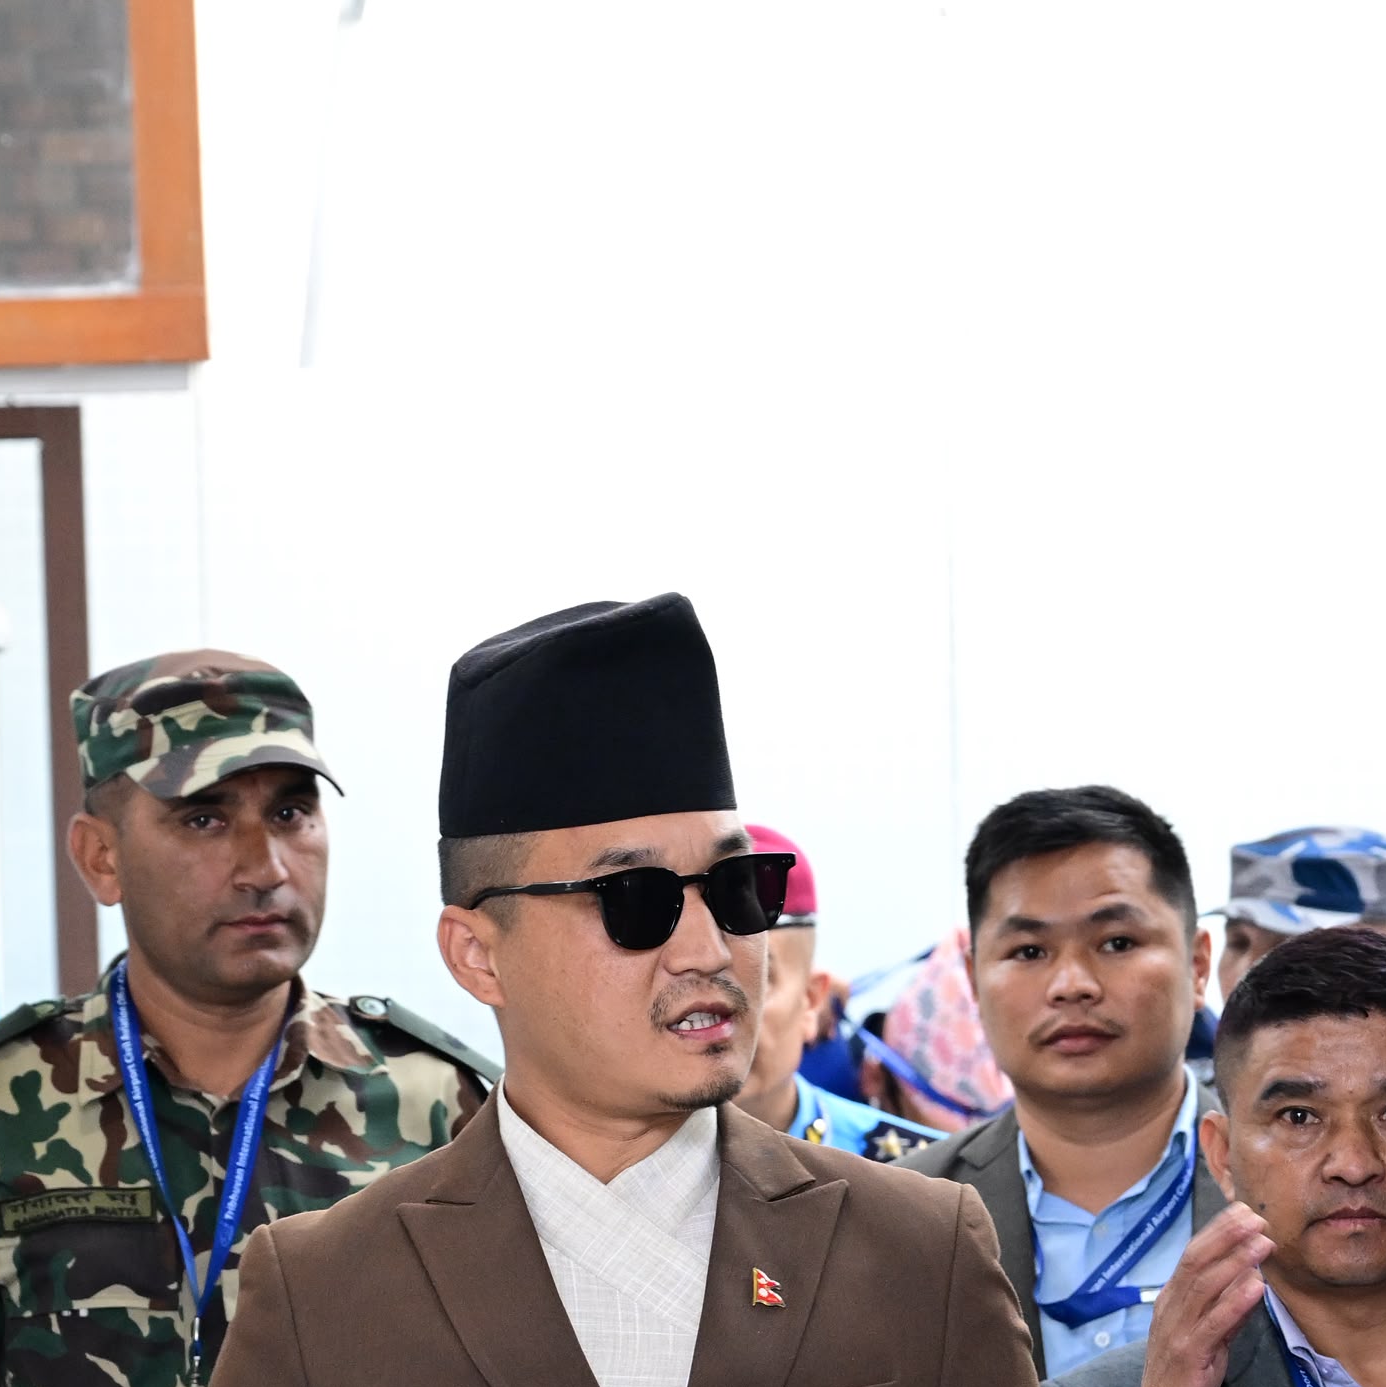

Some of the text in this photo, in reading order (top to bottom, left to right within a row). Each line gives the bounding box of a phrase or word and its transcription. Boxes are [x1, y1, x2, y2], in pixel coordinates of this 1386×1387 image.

[127, 1062, 142, 1101] Airport
[224, 1166, 245, 1220] Tribhuvan
[236, 1100, 259, 1168] International
[1101, 1223, 1155, 1280] International
[1151, 1194, 1179, 1228] Airport
